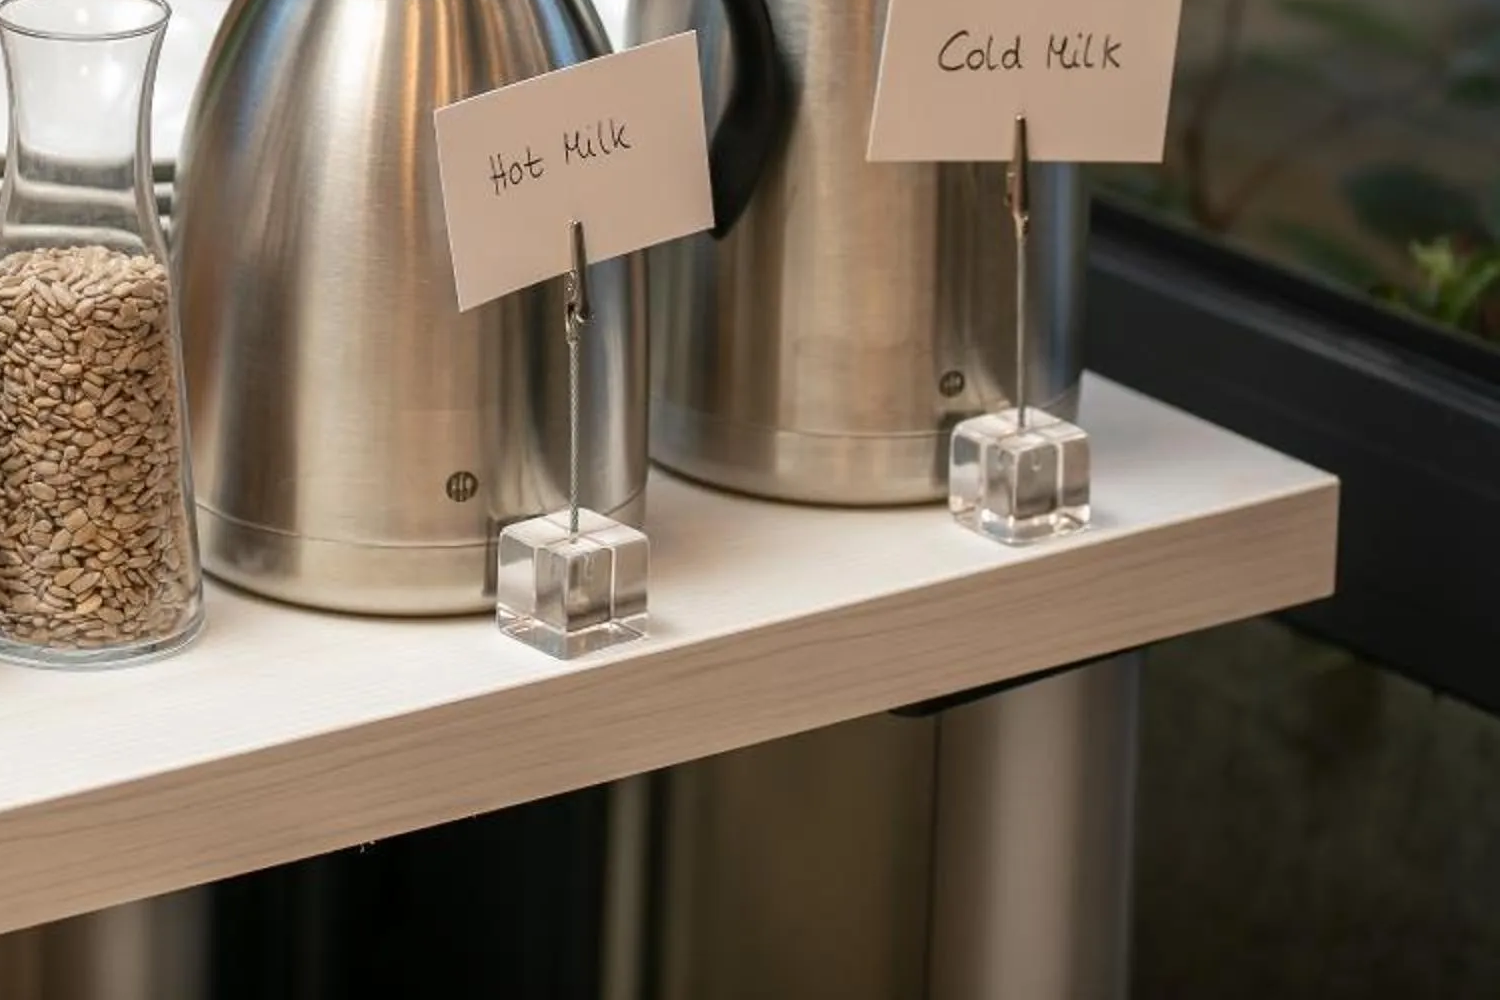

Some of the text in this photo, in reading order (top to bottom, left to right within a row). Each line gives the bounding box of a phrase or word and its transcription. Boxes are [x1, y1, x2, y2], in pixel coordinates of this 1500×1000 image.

[937, 28, 1123, 73] Cold Milk
[488, 118, 632, 196] Hot Milk
